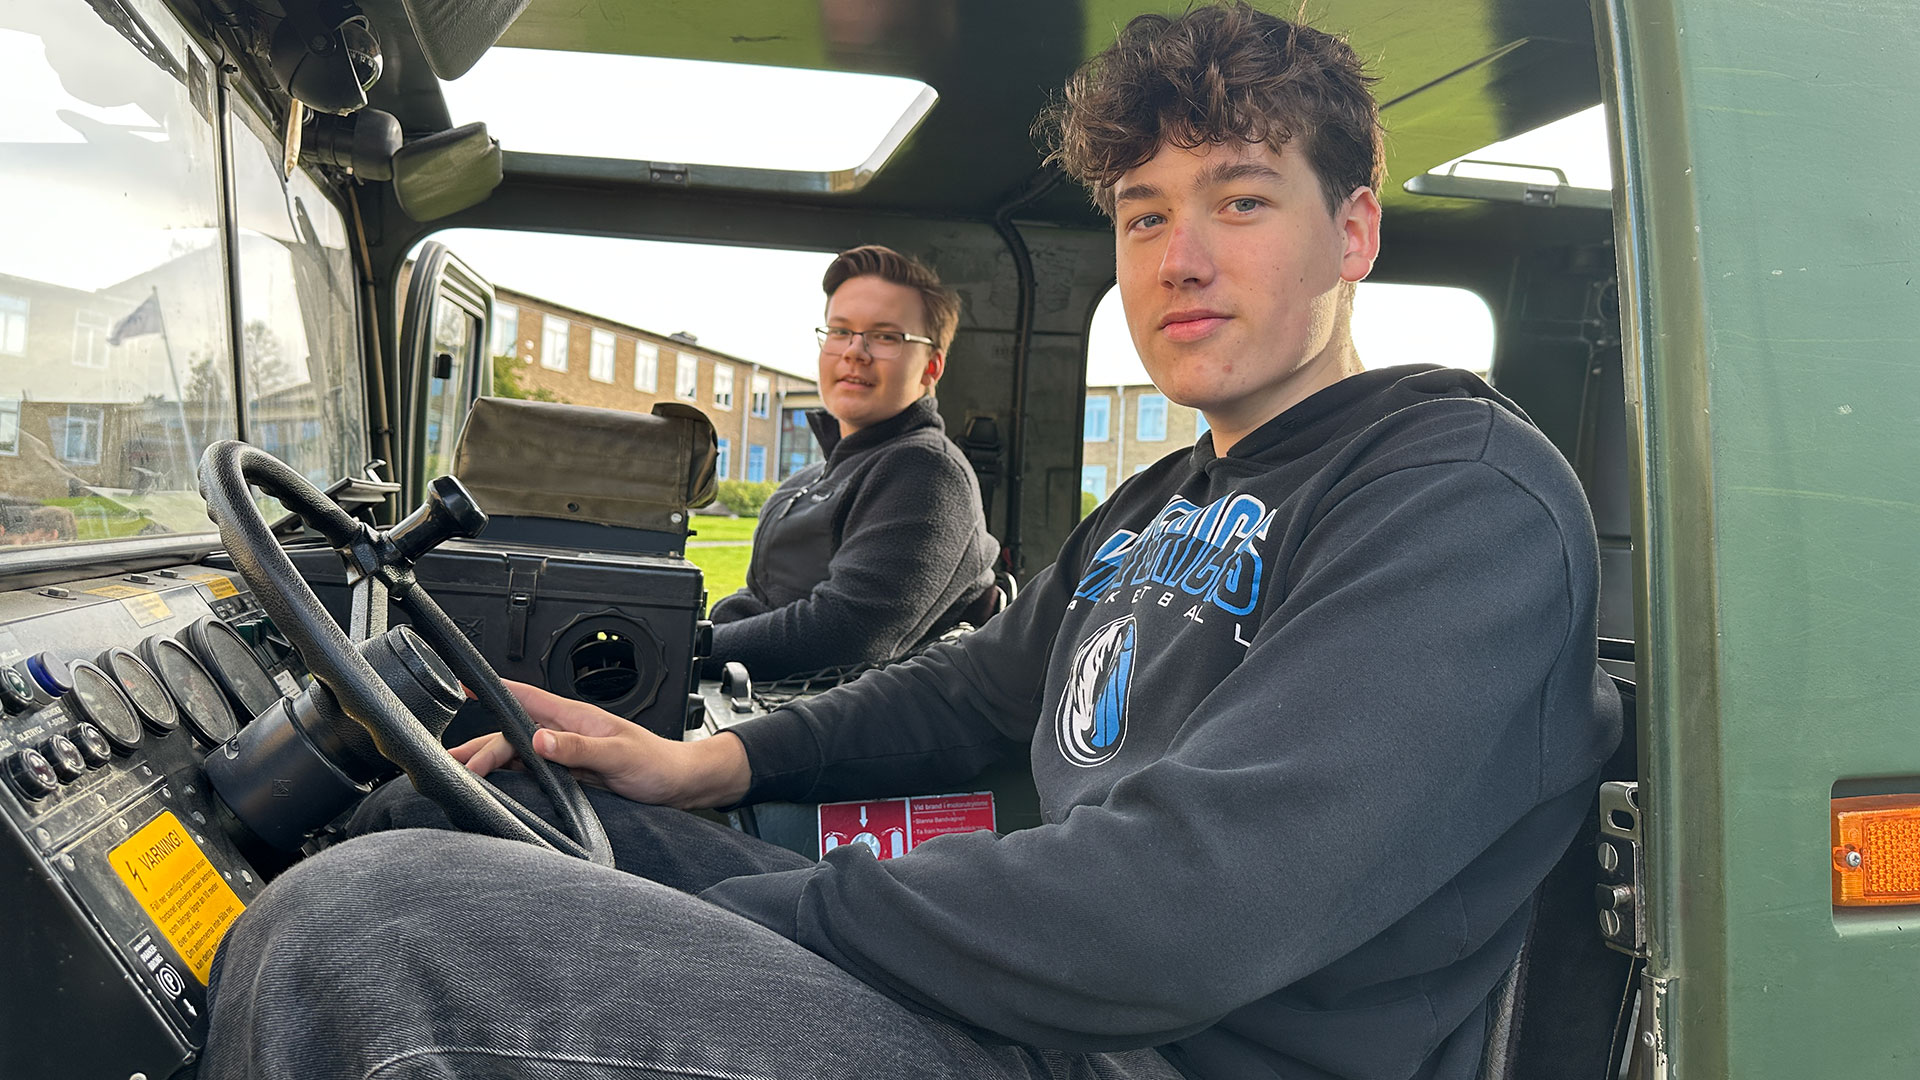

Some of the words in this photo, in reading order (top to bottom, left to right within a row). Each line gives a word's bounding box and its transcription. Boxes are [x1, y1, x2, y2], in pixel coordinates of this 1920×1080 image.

[138, 829, 184, 871] VARNING!
[159, 895, 168, 905] ner
[165, 880, 183, 899] samtliga
[180, 866, 197, 884] antenner
[174, 889, 193, 910] passerar
[190, 880, 203, 893] under
[199, 868, 216, 887] ledning
[168, 923, 180, 936] som
[176, 910, 192, 927] hänger
[188, 901, 201, 914] lägre
[198, 896, 206, 904] än
[208, 882, 219, 895] meter
[176, 934, 188, 948] över
[185, 948, 196, 959] Om
[191, 926, 215, 952] antennerna
[211, 919, 222, 929] inte
[193, 959, 205, 971] kan
[201, 946, 214, 962] detta
[163, 972, 176, 990] P
